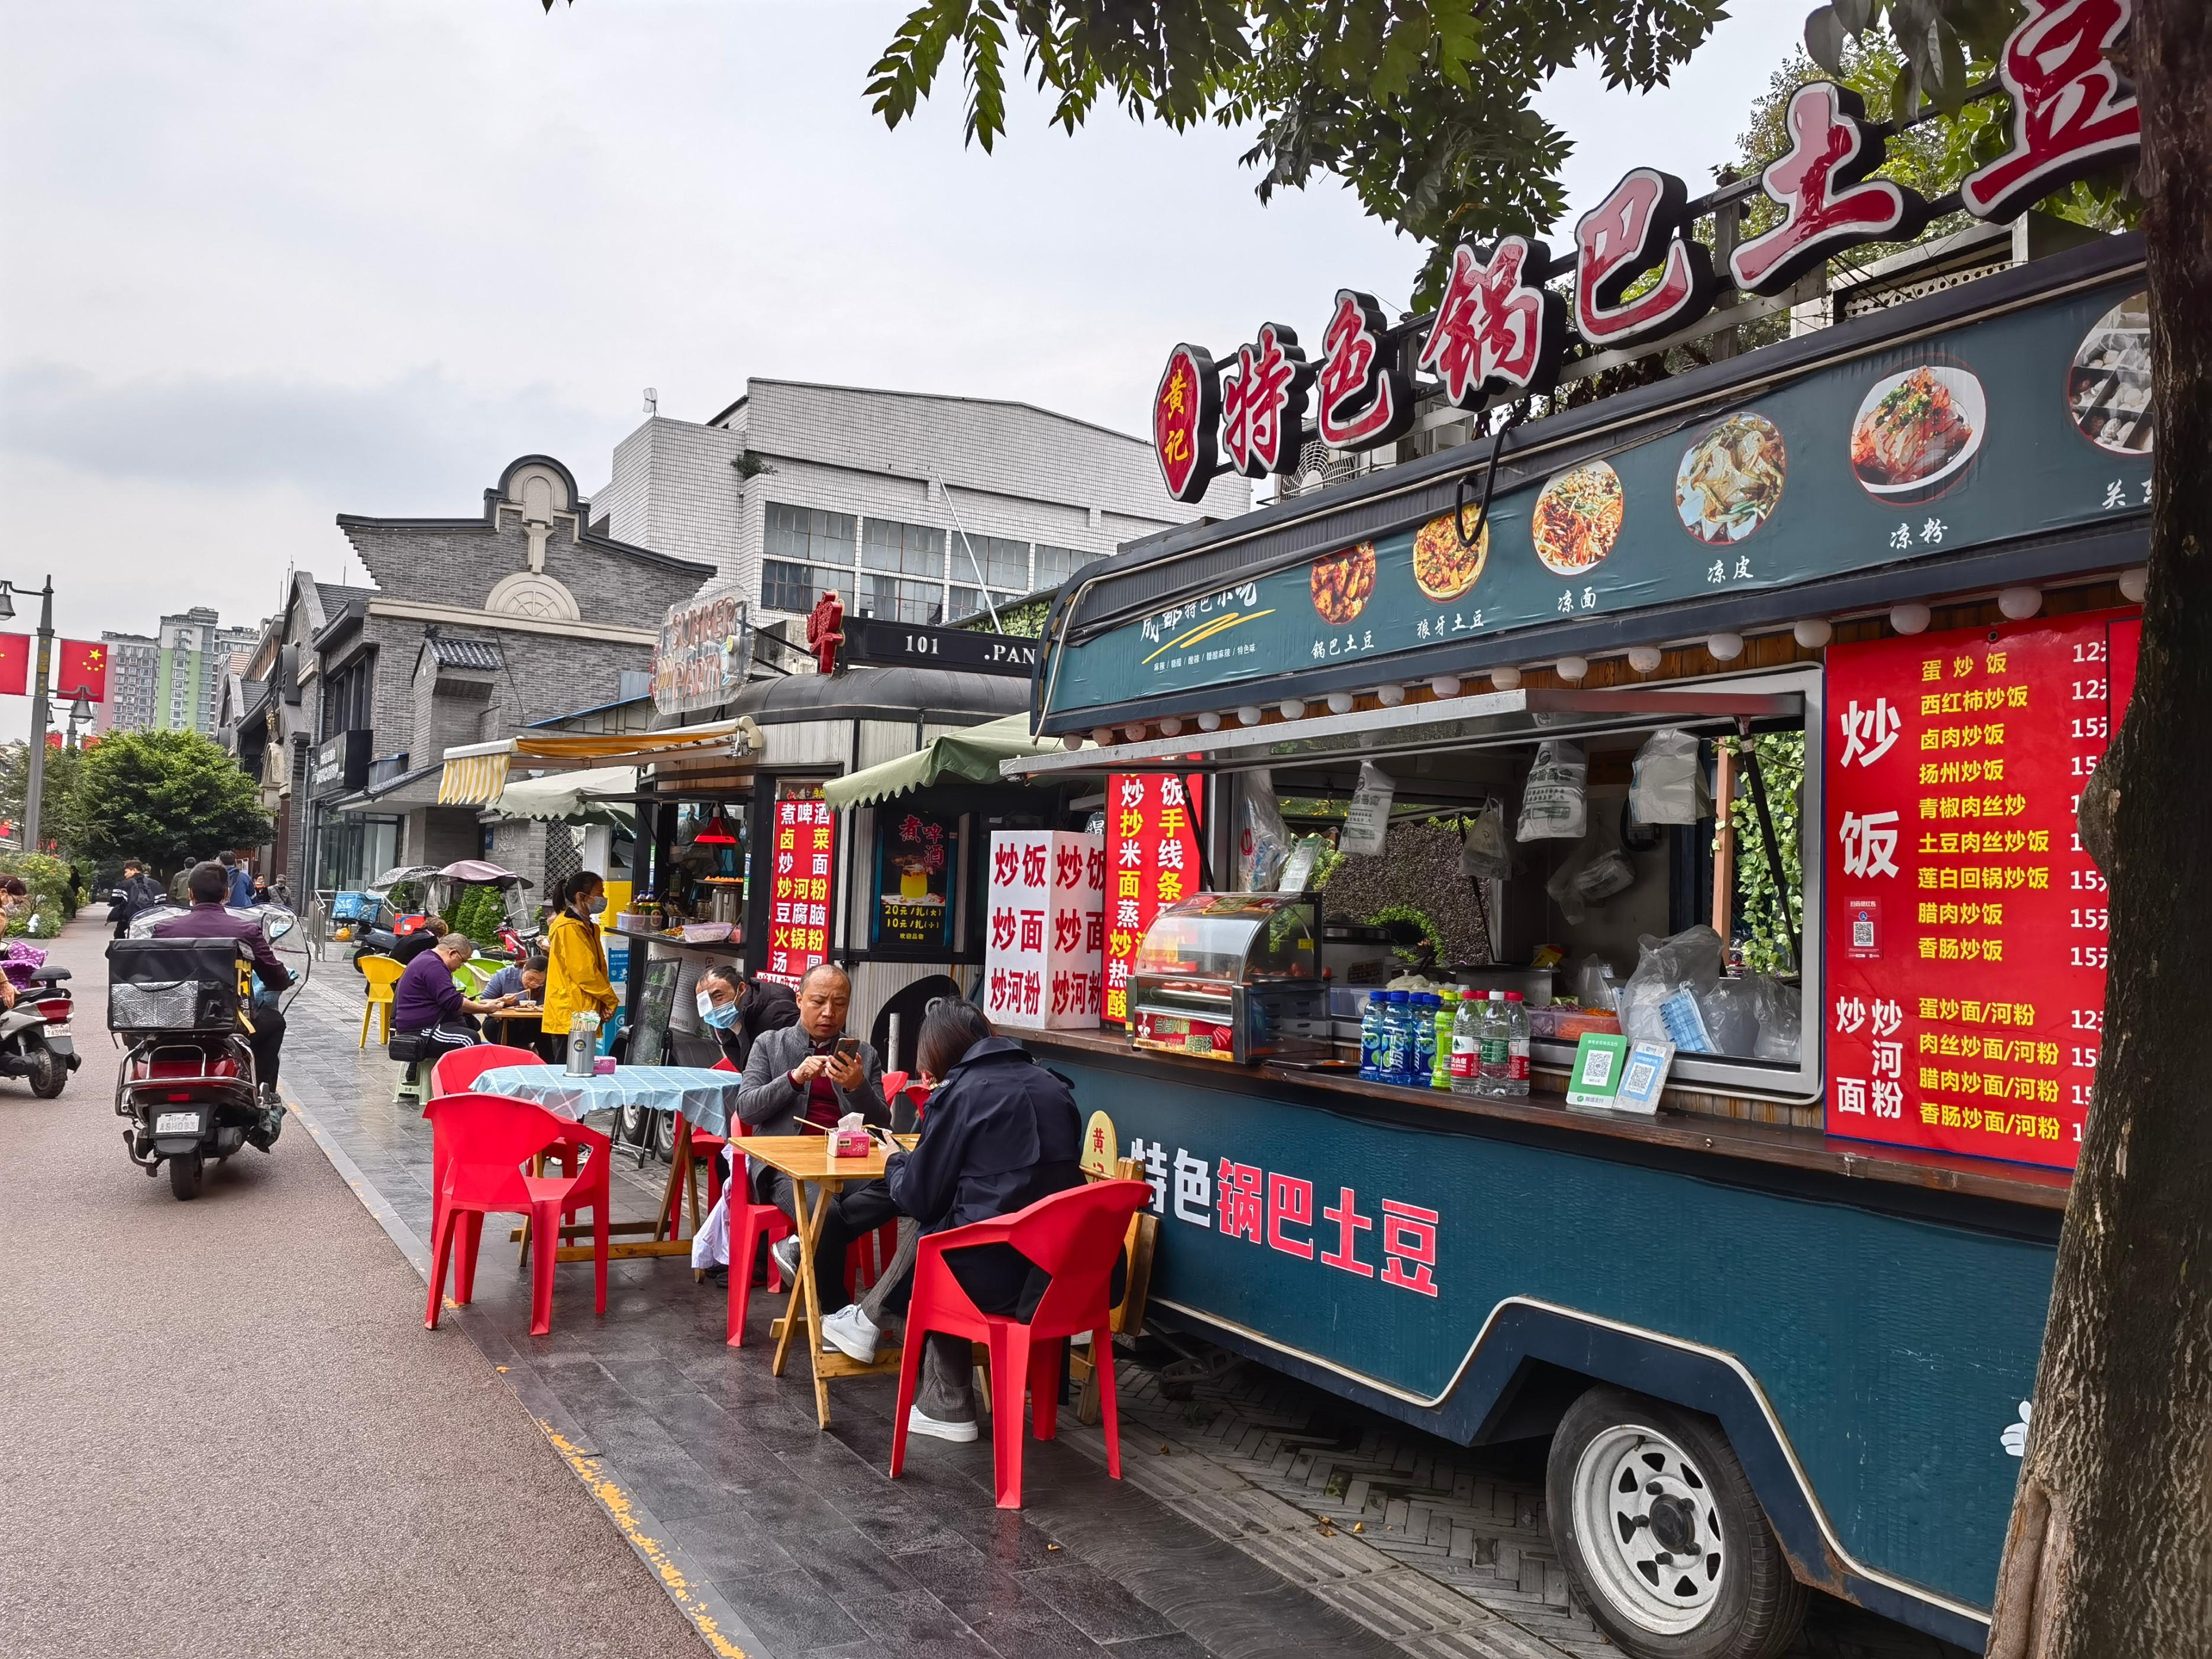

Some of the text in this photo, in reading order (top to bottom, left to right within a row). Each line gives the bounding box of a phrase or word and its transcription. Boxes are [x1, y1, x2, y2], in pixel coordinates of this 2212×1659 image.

[1222, 0, 2140, 473] 特色锅巴土豆
[1164, 370, 1189, 462] 黄记
[1890, 518, 1948, 550] 凉粉
[1707, 556, 1754, 583] 凉皮
[1557, 588, 1597, 614] 凉面
[672, 596, 735, 650] SUMMER
[1416, 610, 1484, 640] 狼牙土豆
[905, 635, 939, 655] 101
[1310, 631, 1374, 659] 锅巴土豆
[673, 653, 721, 700] PARTY
[1921, 652, 2007, 682] 蛋炒饭
[1920, 685, 2028, 716] 西红柿炒饭
[1920, 723, 2004, 750] 卤肉炒饭
[1919, 759, 2004, 785] 扬州炒饭
[780, 802, 830, 825] 煮啤酒
[1919, 793, 2026, 819] 青椒肉丝炒
[780, 828, 830, 850] 卤菜
[1918, 830, 2049, 853] 土豆肉丝炒饭
[778, 853, 828, 875] 炒面
[994, 843, 1047, 888] 炒饭
[1055, 845, 1105, 891] 炒饭
[1917, 867, 2049, 889] 莲白回锅炒饭
[777, 877, 826, 900] 炒河粉
[775, 902, 826, 926] 豆腐脑
[1918, 903, 2003, 926] 腊肉炒饭
[774, 926, 824, 951] 火锅粉
[992, 907, 1045, 954] 炒面
[1918, 938, 2003, 961] 香肠炒饭
[990, 967, 1041, 1015] 炒河粉
[1919, 998, 2035, 1027] 蛋炒面/河粉
[1919, 1032, 2059, 1066] 肉丝炒面/河粉
[1919, 1067, 2059, 1103] 腊肉炒面/河粉
[1919, 1102, 2060, 1140] 香肠炒面/河粉
